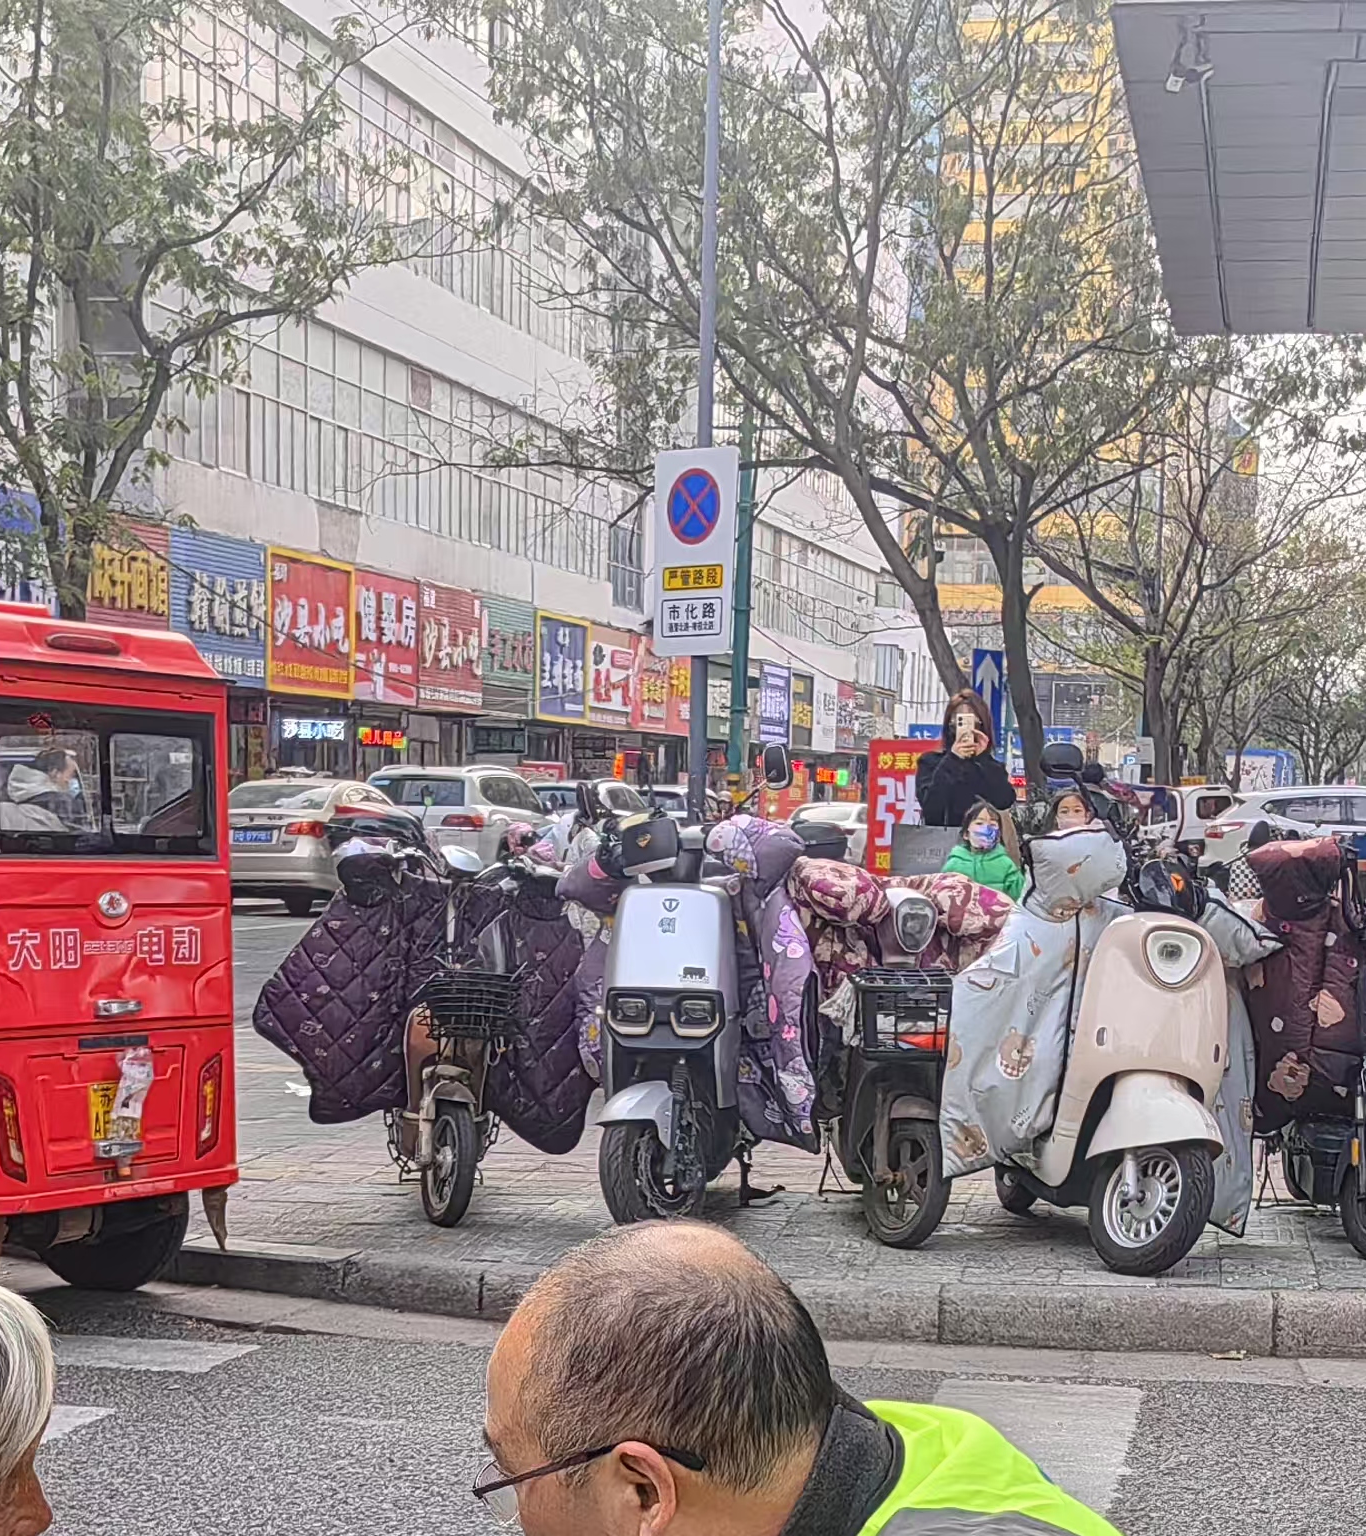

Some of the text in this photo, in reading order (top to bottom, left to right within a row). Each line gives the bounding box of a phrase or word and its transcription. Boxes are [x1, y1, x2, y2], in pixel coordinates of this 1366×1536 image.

[668, 567, 718, 587] 严管路段
[667, 602, 716, 621] 市化路
[281, 718, 345, 742] 沙县小吃
[7, 928, 81, 971] 大阳
[136, 926, 201, 966] 电动
